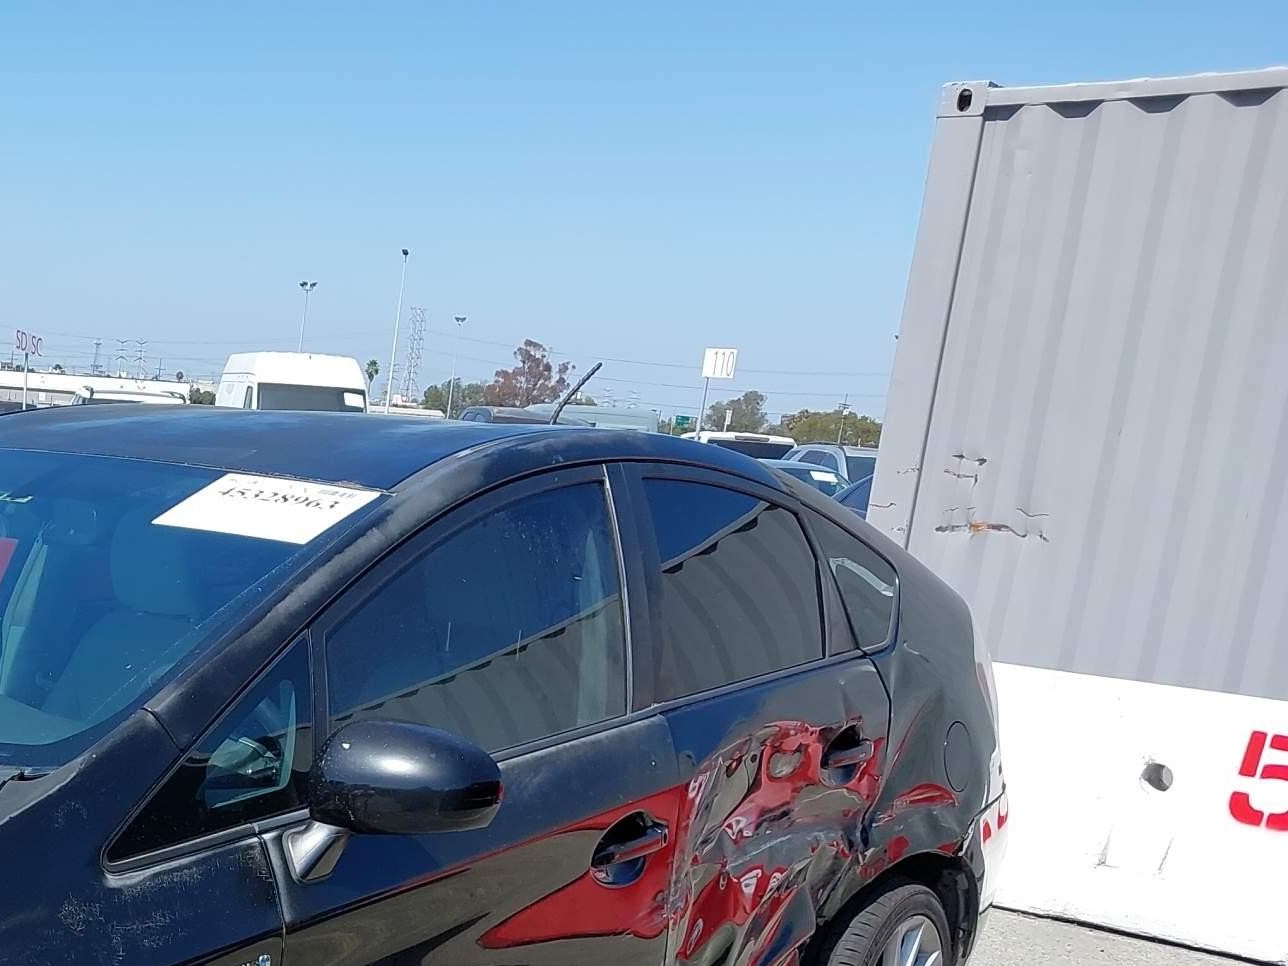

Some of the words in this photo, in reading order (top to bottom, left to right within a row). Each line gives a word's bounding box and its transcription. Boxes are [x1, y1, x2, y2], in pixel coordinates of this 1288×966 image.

[15, 329, 27, 351] SD
[31, 335, 43, 357] SC
[712, 351, 735, 376] 110
